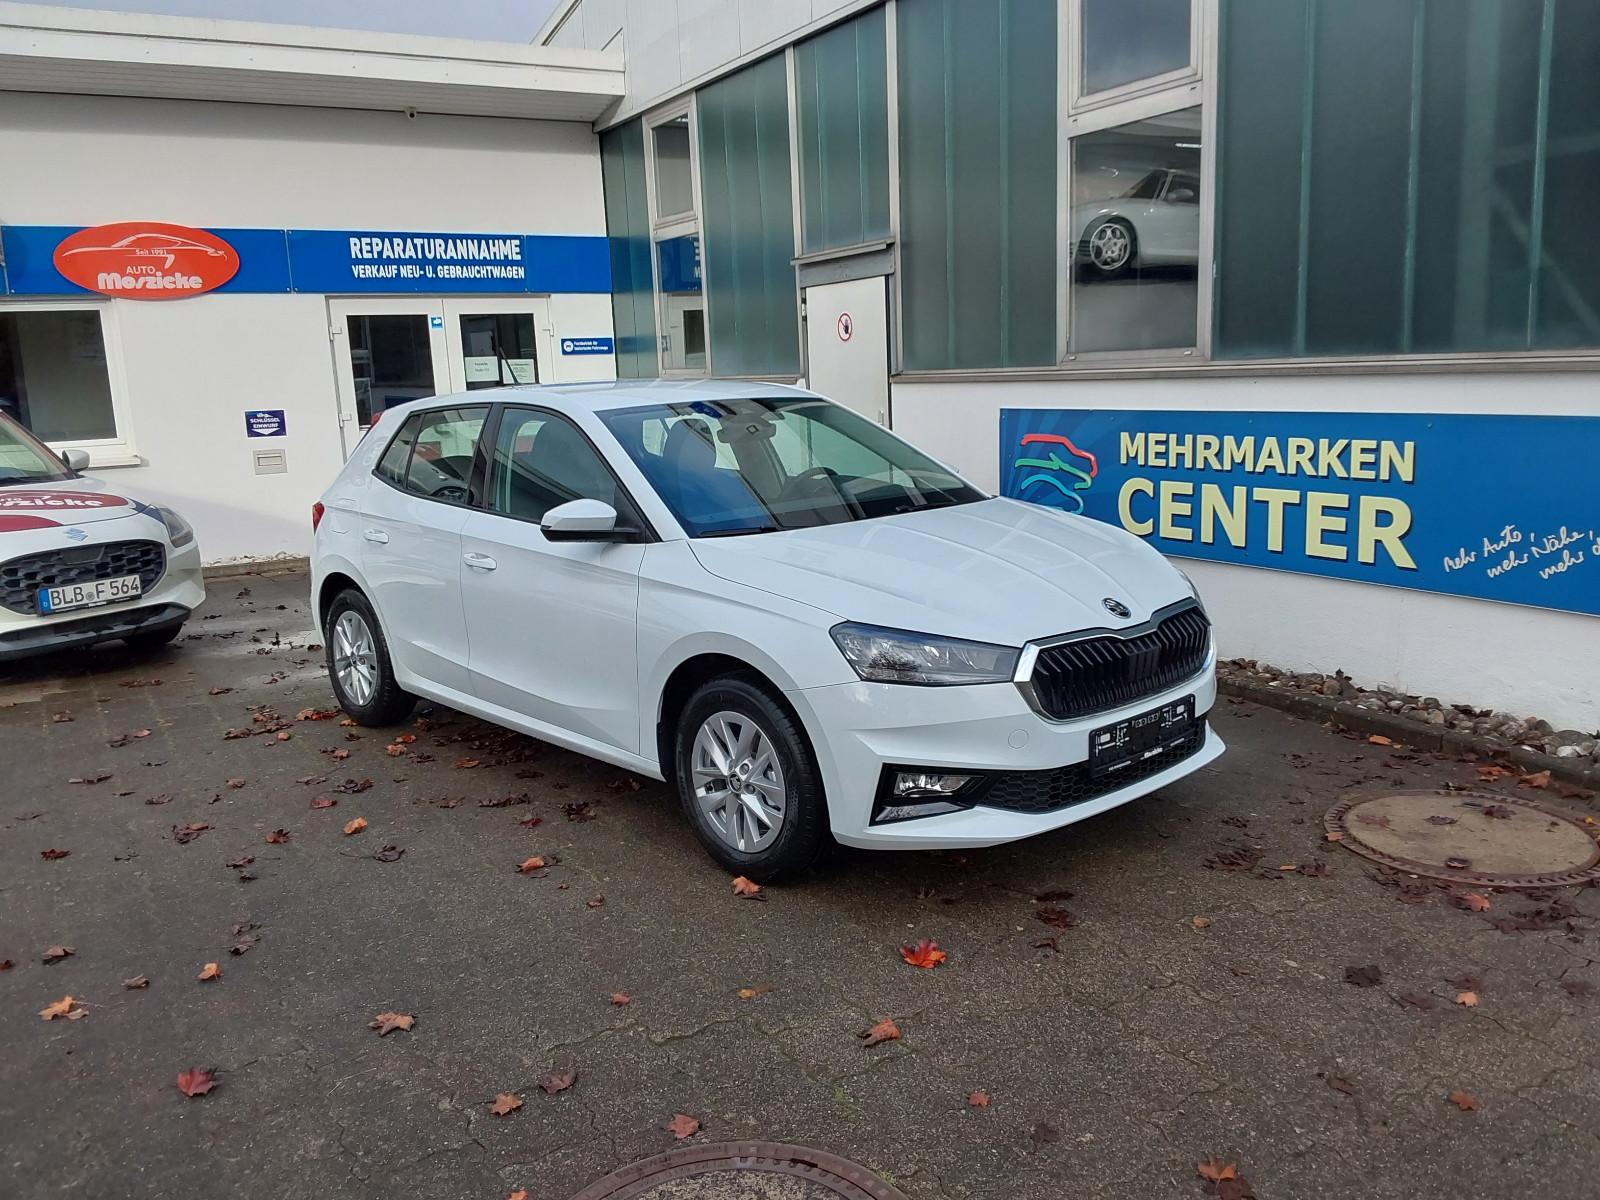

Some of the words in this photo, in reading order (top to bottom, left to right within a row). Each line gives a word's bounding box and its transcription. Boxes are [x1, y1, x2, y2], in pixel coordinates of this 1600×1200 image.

[350, 237, 521, 261] REPARATURANNAHME
[126, 265, 156, 275] AUTO
[352, 265, 398, 278] VERKAUF
[400, 265, 424, 278] NEU-
[426, 266, 436, 278] U.
[437, 266, 525, 279] GEBRAUCHTWAGEN
[1119, 431, 1415, 483] MEHRMARKEN
[1118, 477, 1418, 569] CENTER
[1486, 550, 1529, 578] mehr
[1538, 550, 1584, 579] mehr
[50, 586, 85, 606] BLB
[95, 582, 105, 599] F
[109, 577, 140, 596] 564
